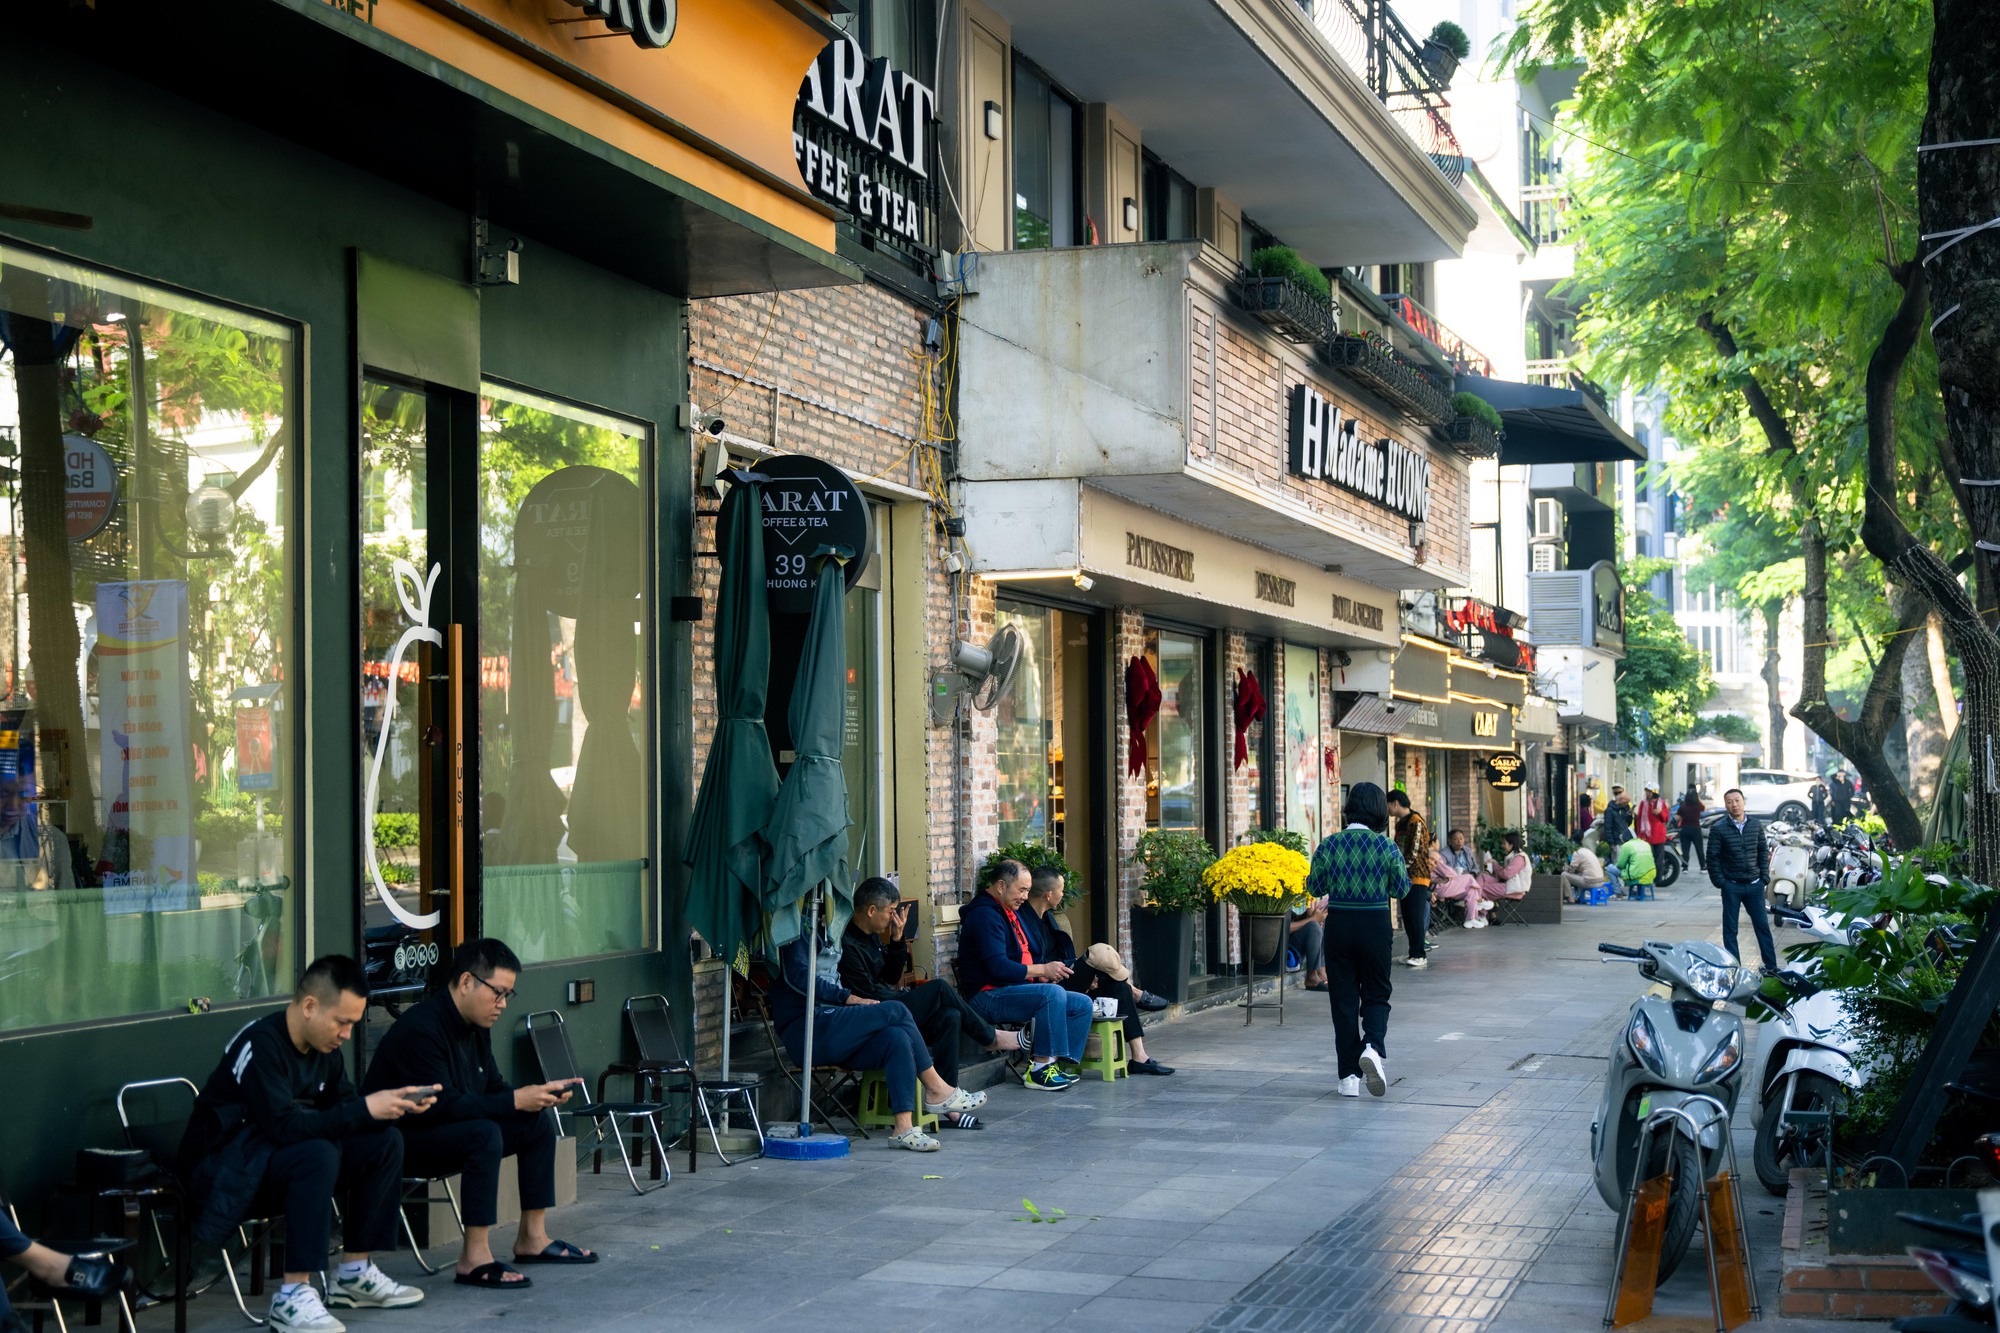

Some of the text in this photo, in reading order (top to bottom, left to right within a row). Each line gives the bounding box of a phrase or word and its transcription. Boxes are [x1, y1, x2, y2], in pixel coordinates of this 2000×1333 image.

[797, 35, 934, 180] ARAT
[793, 131, 919, 242] FFEE & TEA
[1302, 385, 1431, 523] H Madame HUONG
[761, 491, 848, 512] ARAT
[762, 517, 829, 527] OFFEE & TEA
[775, 554, 806, 576] 39
[1126, 531, 1195, 583] PATISSERIE
[767, 579, 808, 589] HUONG
[1255, 570, 1297, 608] DESSERT
[1475, 711, 1498, 736] CARAT
[1490, 759, 1521, 767] CARAT
[1501, 775, 1511, 783] 39
